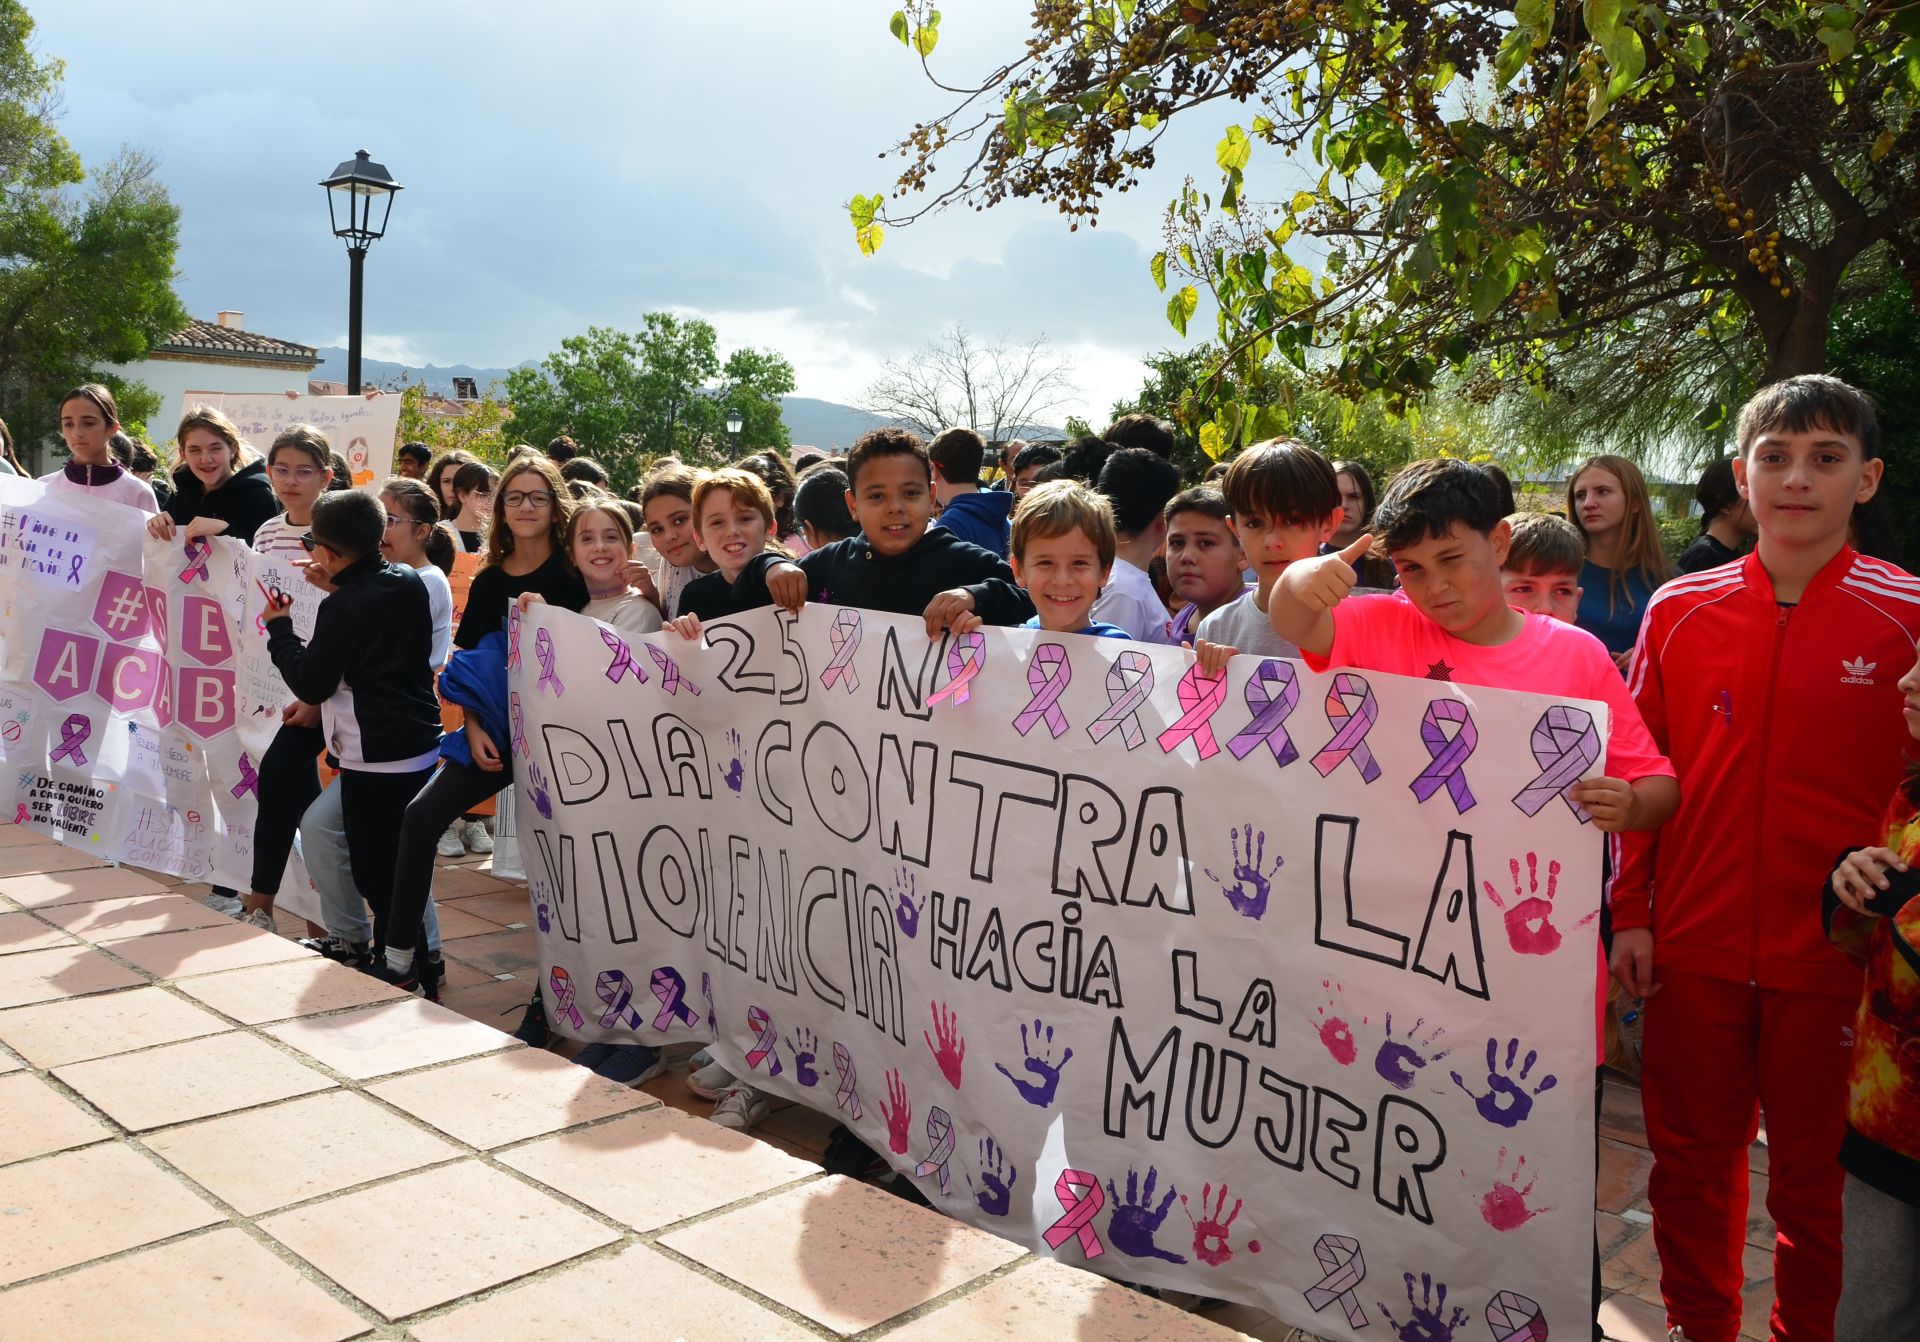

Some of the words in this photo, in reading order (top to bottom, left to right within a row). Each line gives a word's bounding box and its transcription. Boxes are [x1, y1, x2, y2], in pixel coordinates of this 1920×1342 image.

[704, 607, 809, 705] 25
[877, 625, 951, 720] N
[1840, 676, 1874, 685] adidas
[30, 789, 37, 797] A
[40, 790, 65, 801] CASA
[32, 801, 53, 812] SER
[34, 815, 47, 823] NO
[541, 713, 713, 806] DIA
[755, 719, 1195, 917] CONTRA
[1315, 813, 1490, 1001] LA
[534, 824, 907, 1047] VIOLENCIA
[1172, 948, 1277, 1048] LA
[1103, 1015, 1447, 1226] MUJER
